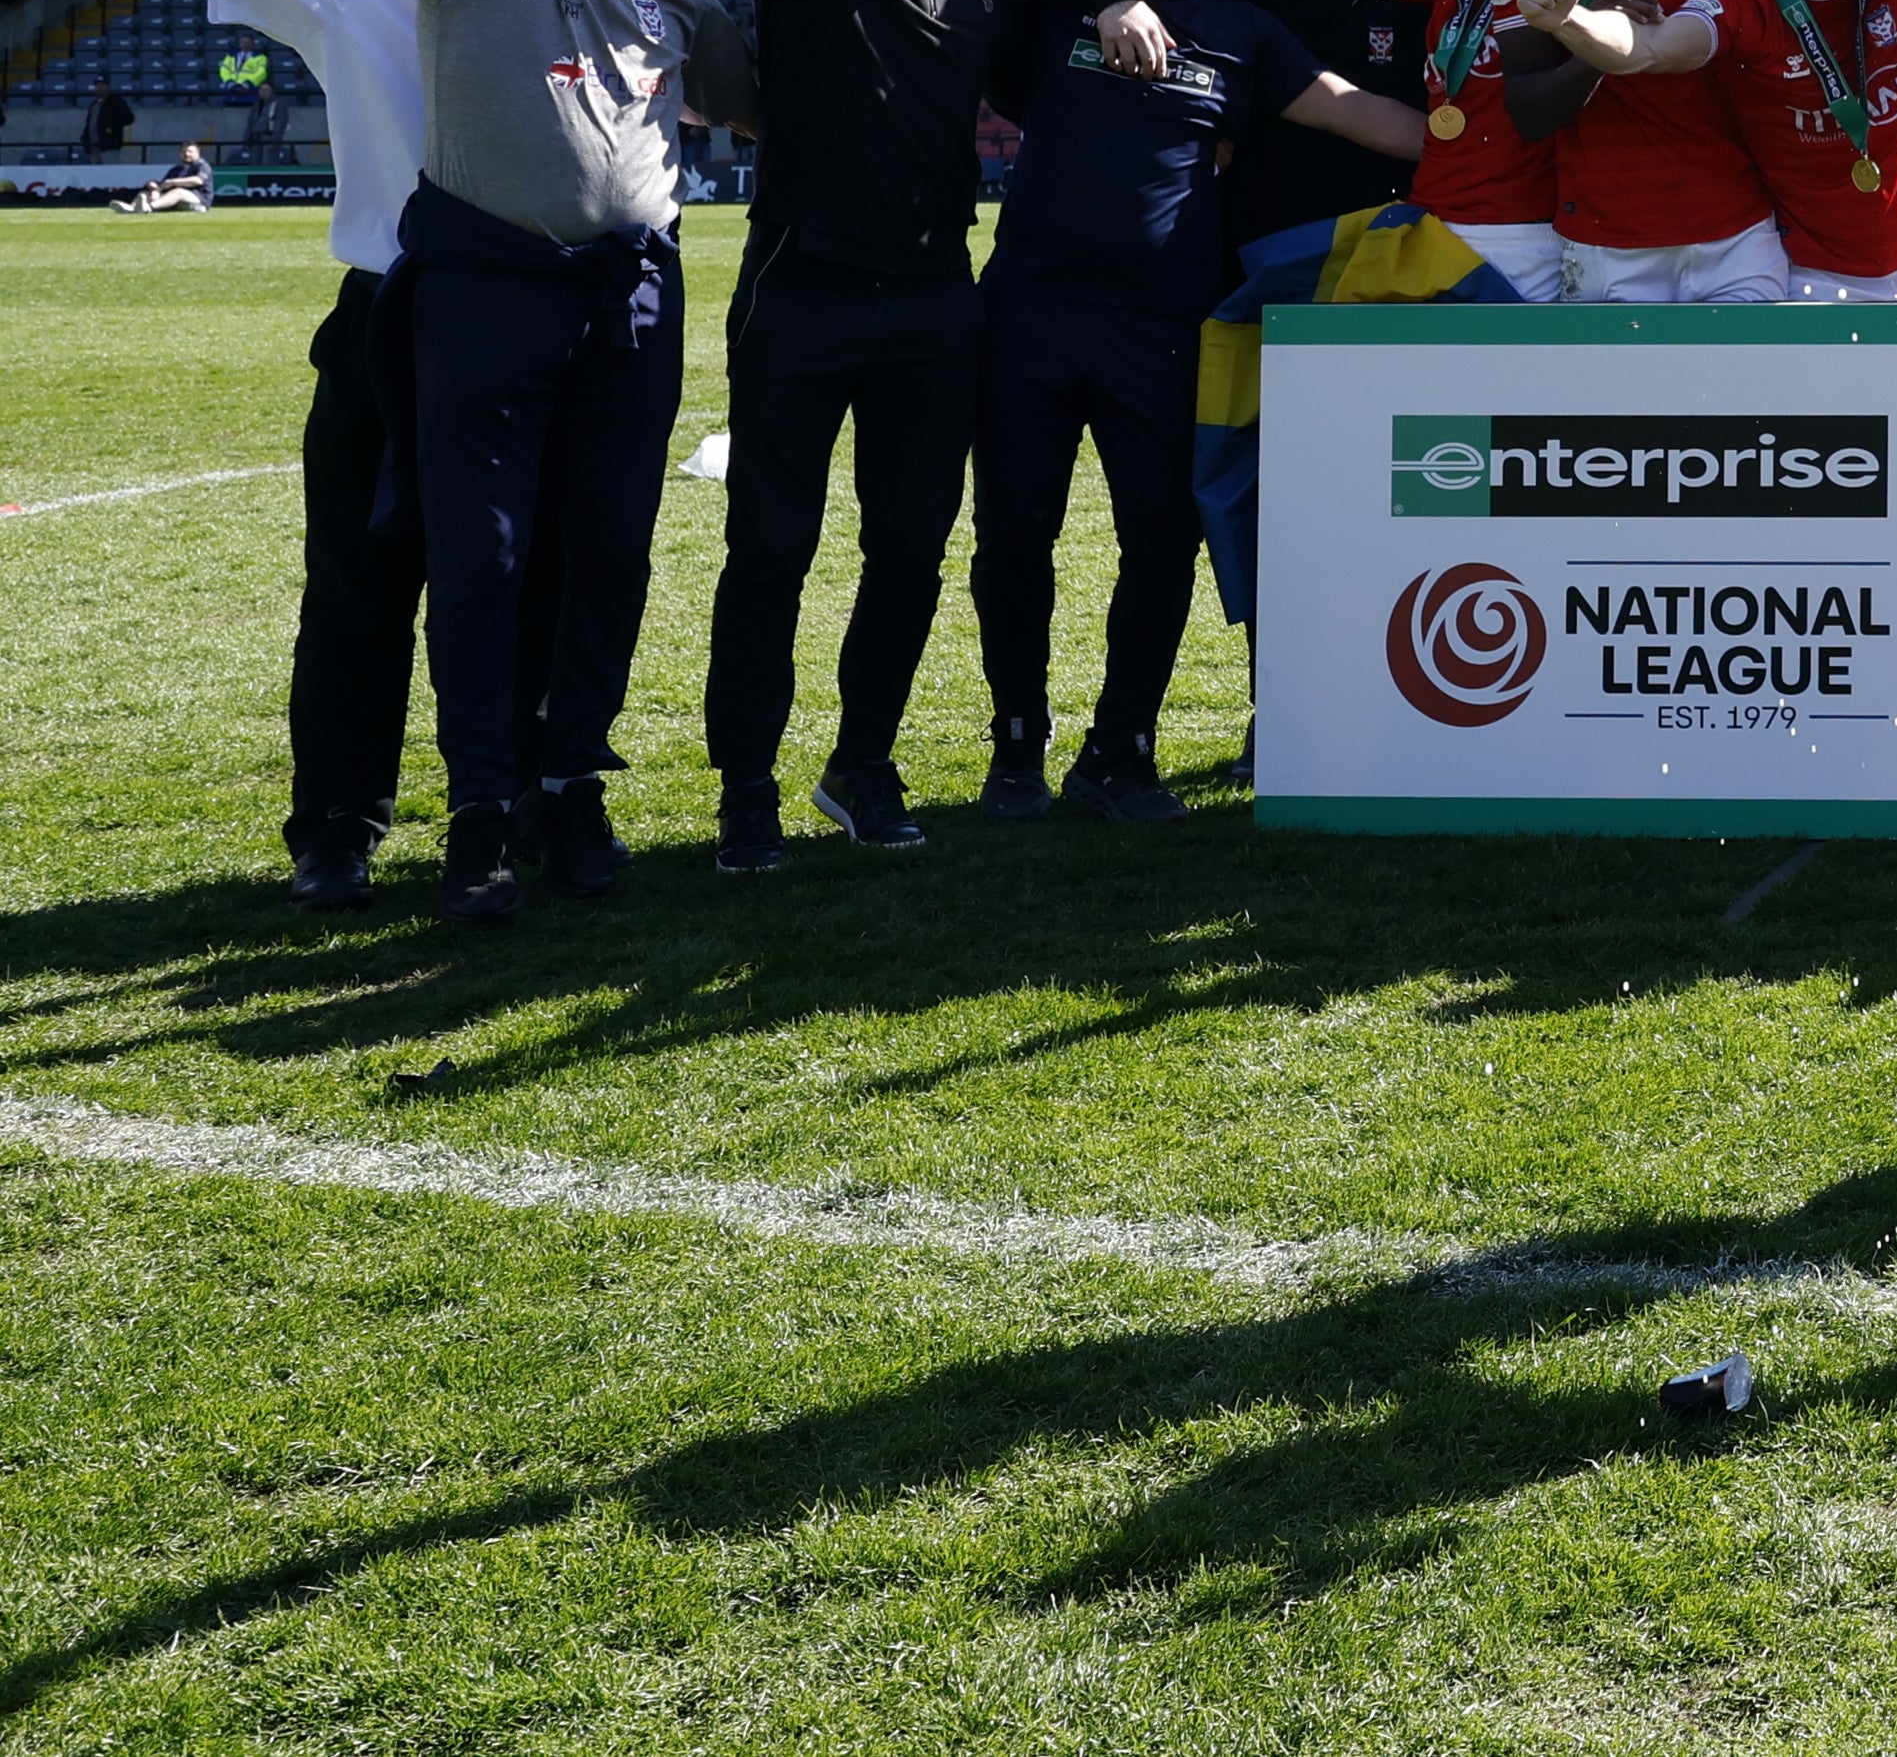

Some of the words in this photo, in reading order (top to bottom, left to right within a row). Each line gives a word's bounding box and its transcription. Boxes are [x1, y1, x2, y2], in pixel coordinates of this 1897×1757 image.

[1792, 9, 1841, 100] enterprise
[1415, 433, 1880, 503] enterprise
[1564, 586, 1891, 636] NATIONAL
[1602, 646, 1853, 696] LEAGUE
[1658, 706, 1717, 730] EST.
[1727, 705, 1798, 731] 1979
